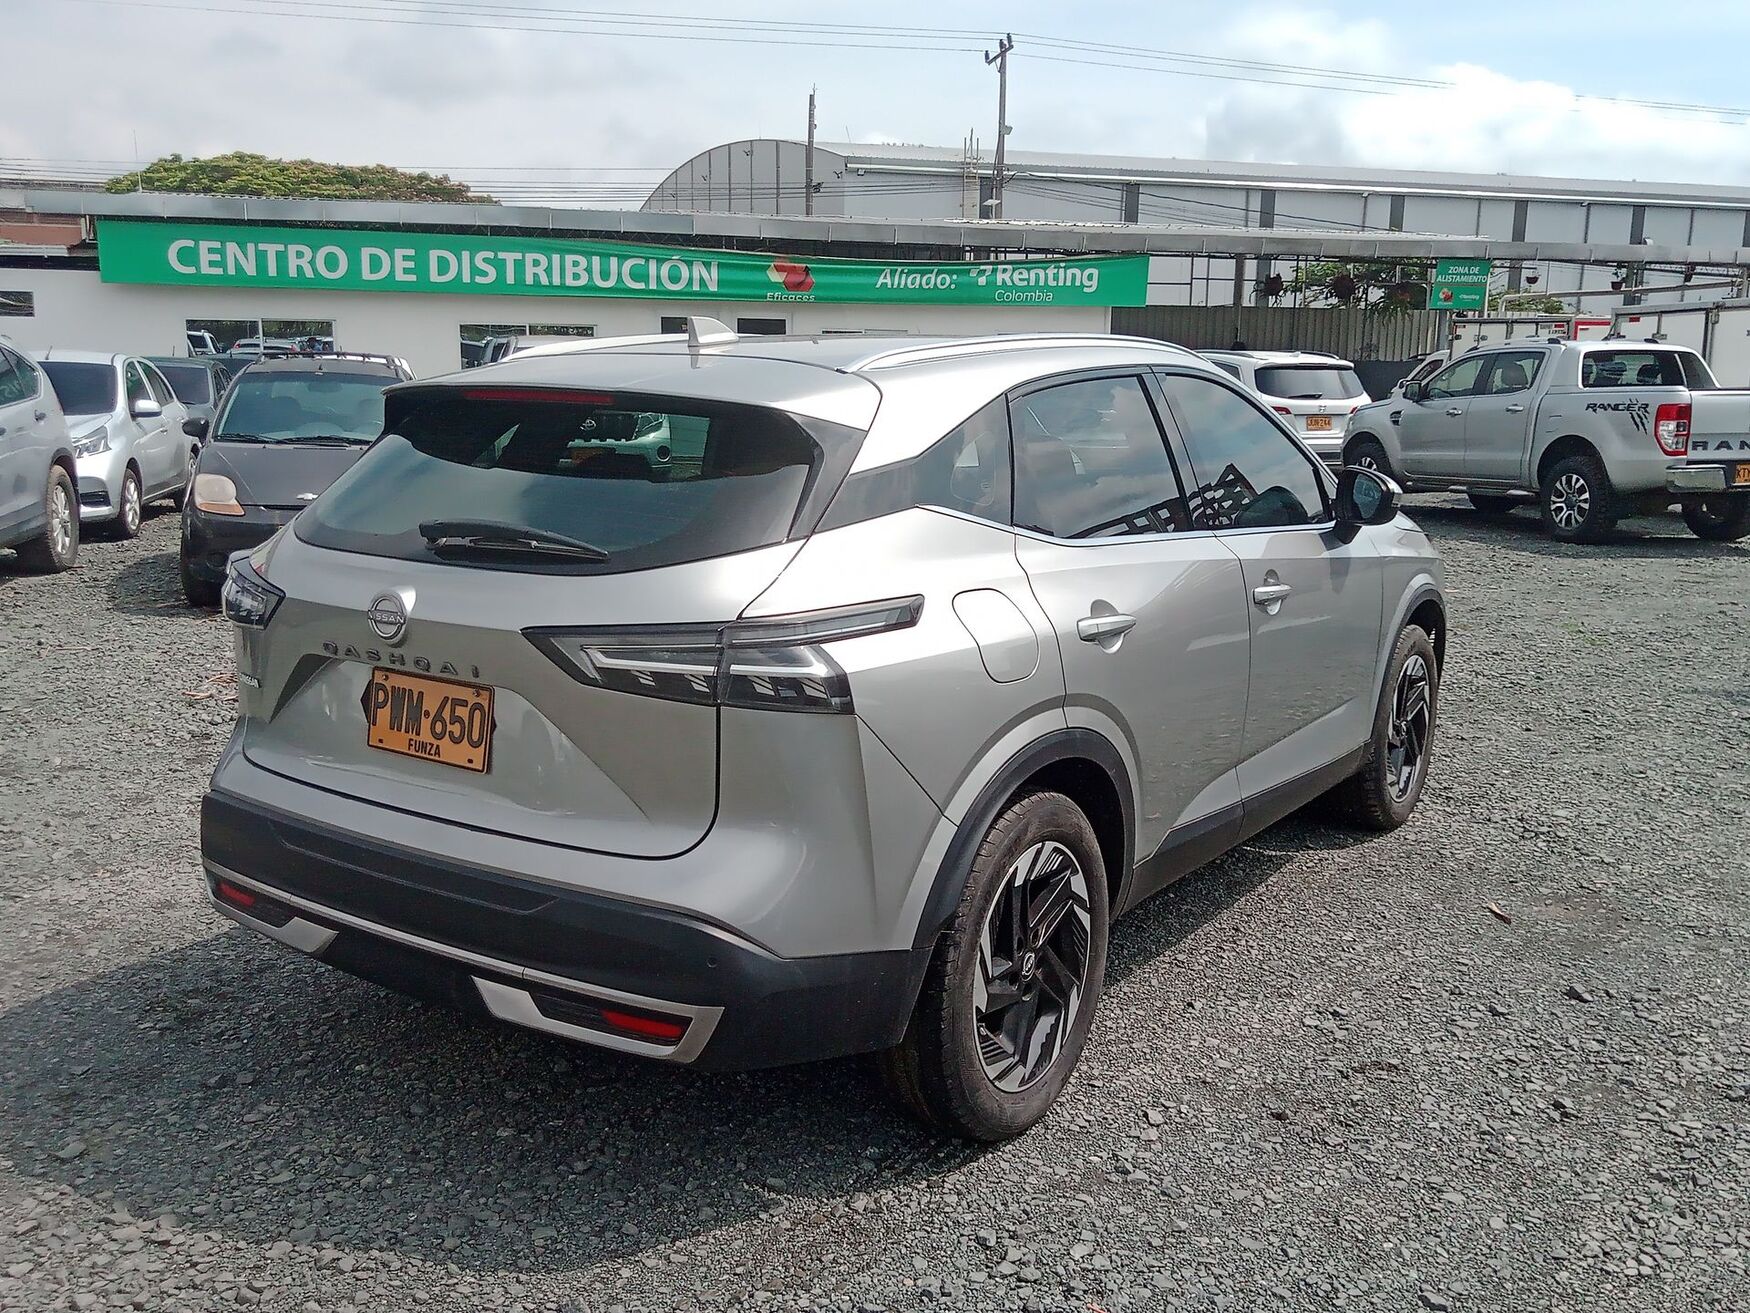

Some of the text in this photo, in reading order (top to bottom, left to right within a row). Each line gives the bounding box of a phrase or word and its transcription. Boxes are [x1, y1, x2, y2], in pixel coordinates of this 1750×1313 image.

[167, 239, 719, 292] CENTRO DE DISTRIBUCIÓN
[1448, 266, 1480, 274] ZONA DE
[875, 263, 1099, 293] Aliado: Renting
[1436, 274, 1487, 282] ALISTAMIENTO
[766, 292, 816, 301] Eficaces
[995, 289, 1053, 302] Colombia
[1585, 403, 1650, 413] RANGER
[368, 610, 406, 624] NISSAN
[322, 641, 479, 679] QASHQAI
[407, 738, 441, 758] FUNZA
